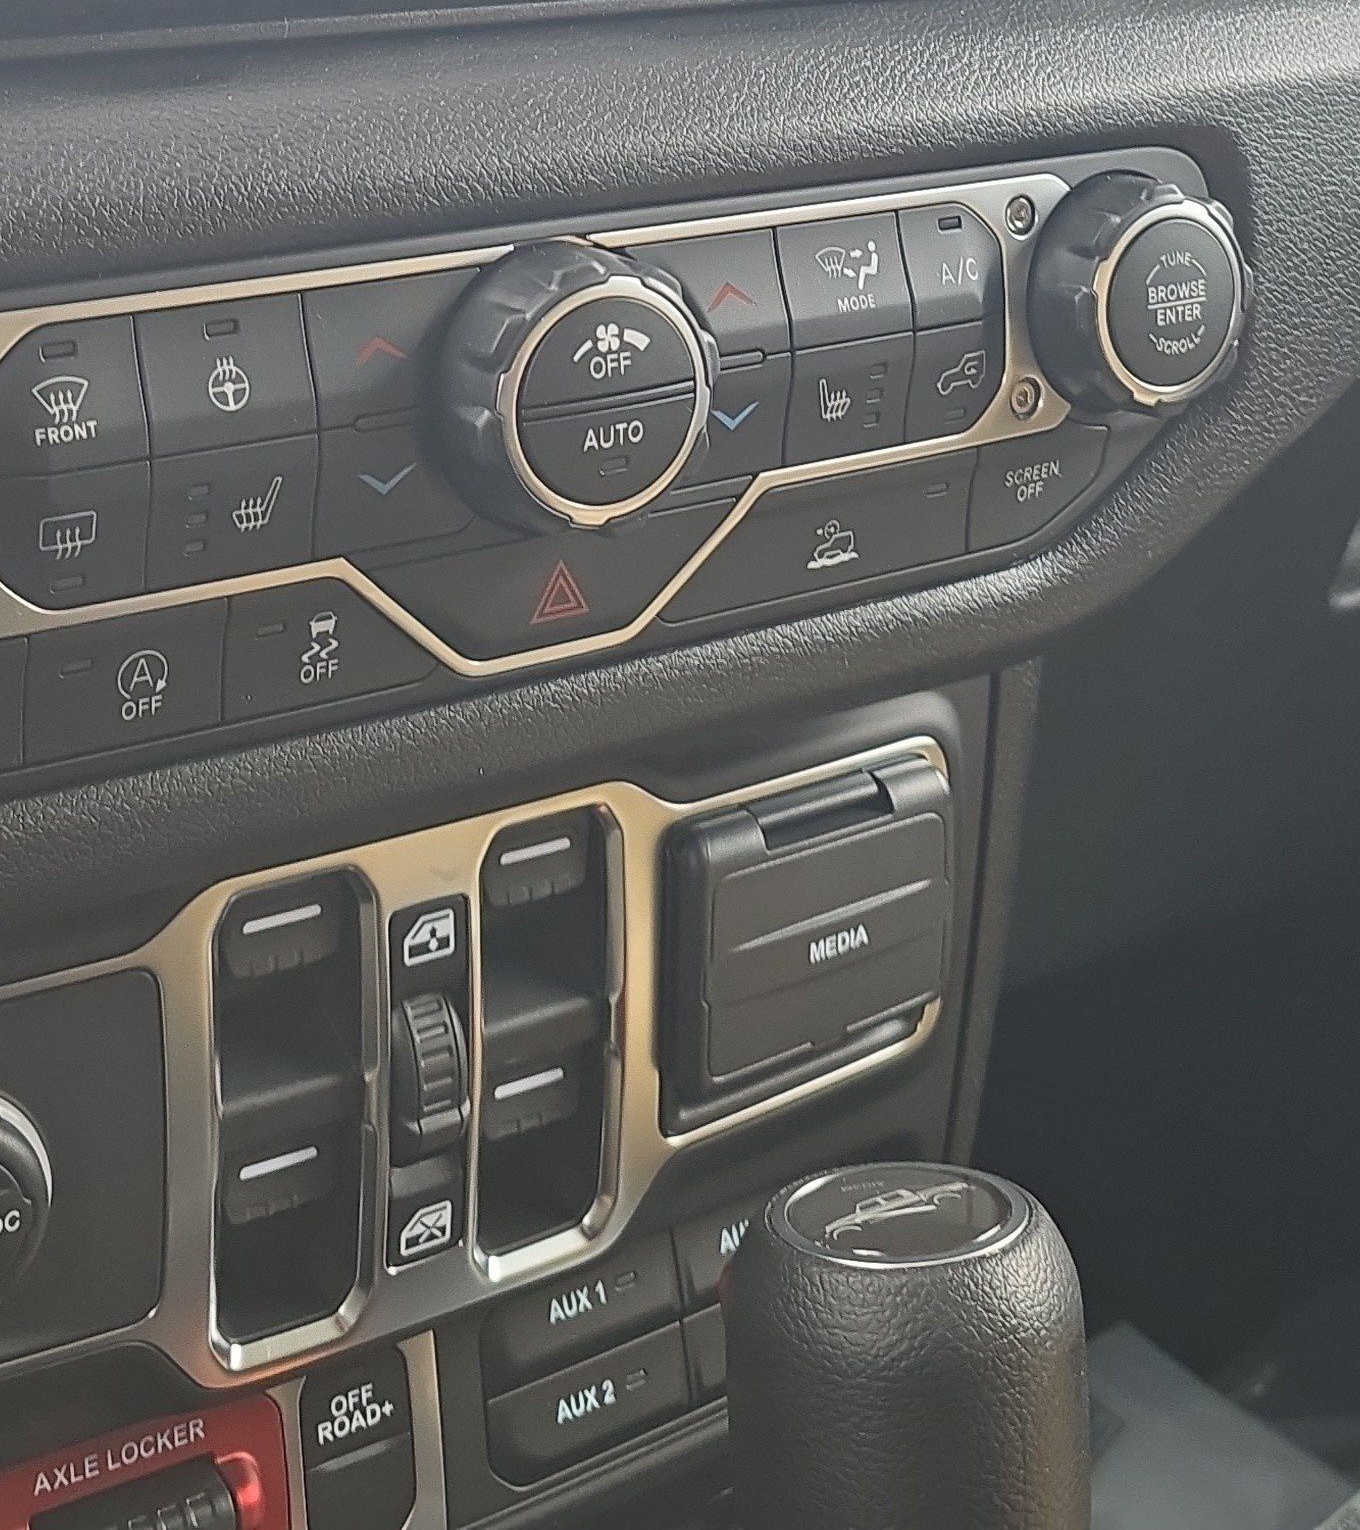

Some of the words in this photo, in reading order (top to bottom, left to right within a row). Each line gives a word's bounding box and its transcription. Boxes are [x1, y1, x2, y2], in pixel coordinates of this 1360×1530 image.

[941, 258, 979, 283] A/C
[1160, 251, 1192, 268] TUNE
[837, 294, 877, 312] MODE
[1147, 279, 1206, 304] BROWSE
[1156, 303, 1202, 326] ENTER
[1155, 332, 1201, 355] SCROLL
[590, 353, 632, 380] OFF
[35, 420, 98, 444] FRONT
[583, 421, 644, 453] AUTO
[1005, 461, 1062, 487] SCREEN
[1016, 481, 1044, 502] OFF
[299, 658, 340, 684] OFF
[121, 695, 163, 720] OFF
[808, 924, 869, 964] MEDIA
[548, 1291, 593, 1325] AUX
[330, 1382, 375, 1418] OFF
[554, 1385, 600, 1425] AUX
[601, 1380, 617, 1404] 2
[32, 1453, 101, 1497] AXLE
[105, 1416, 206, 1472] LOCKER
